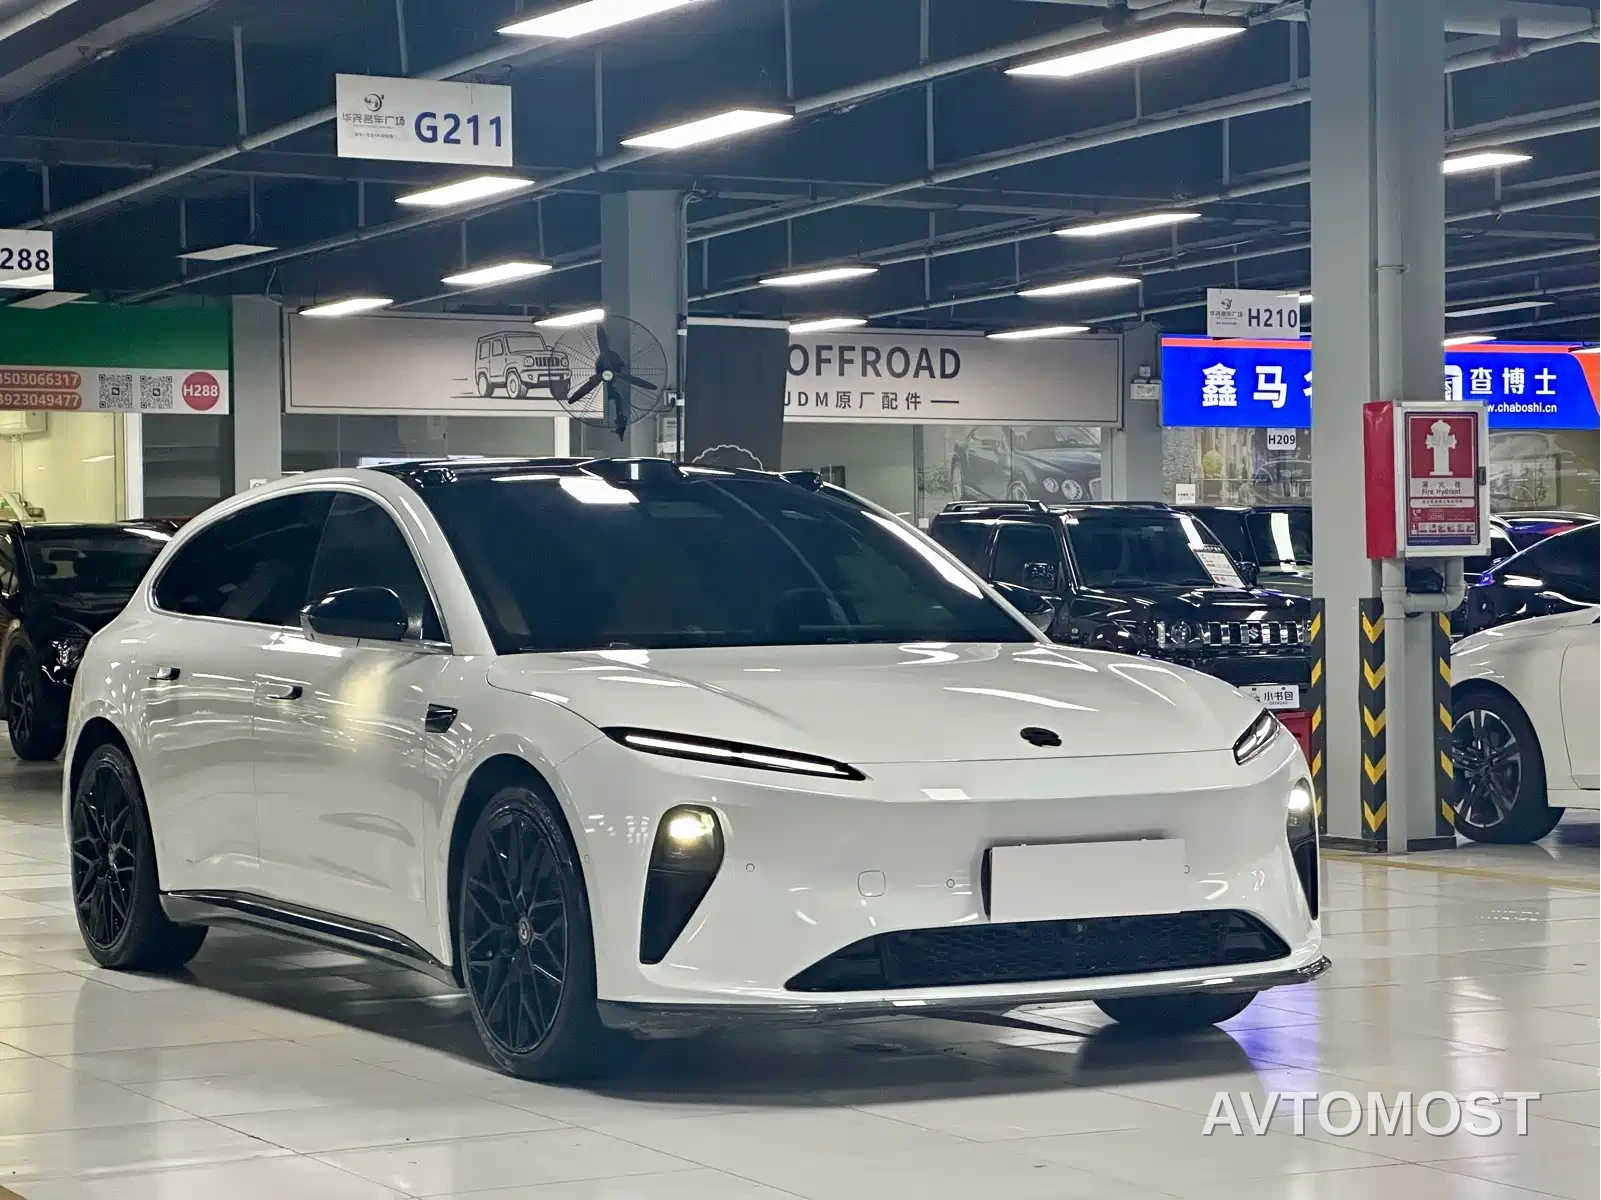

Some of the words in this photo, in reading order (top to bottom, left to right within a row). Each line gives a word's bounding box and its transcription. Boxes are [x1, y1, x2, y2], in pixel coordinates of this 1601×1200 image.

[414, 111, 503, 147] G211
[0, 247, 50, 271] 288
[1248, 308, 1298, 328] H210
[786, 343, 961, 379] OFFROAD
[183, 387, 219, 397] H288
[1469, 367, 1557, 395] 查博士
[1268, 434, 1296, 445] H209
[1264, 691, 1294, 701] 小书包
